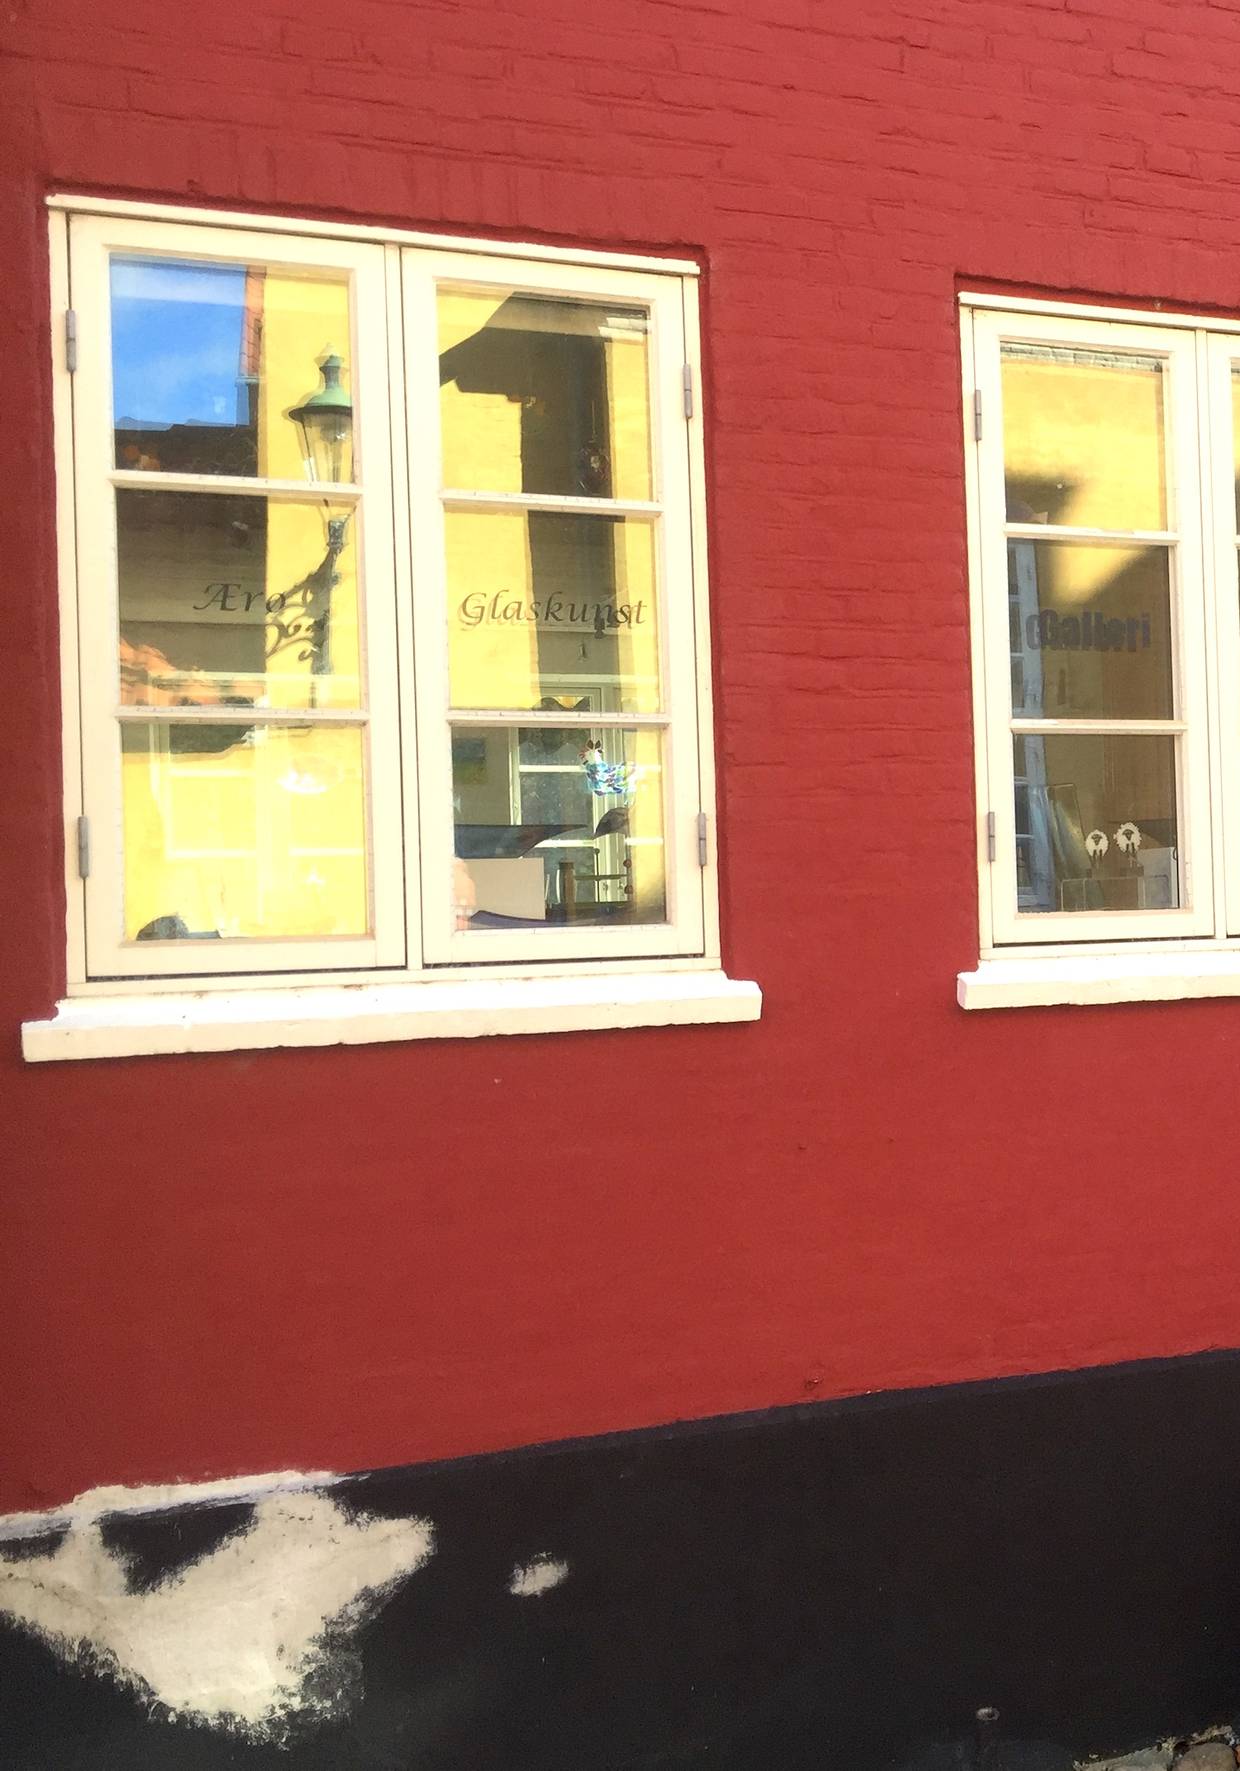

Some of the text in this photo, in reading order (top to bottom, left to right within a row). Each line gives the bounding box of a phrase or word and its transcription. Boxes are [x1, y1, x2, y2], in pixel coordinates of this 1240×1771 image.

[192, 582, 647, 625] Ærø Glaskunst
[1030, 608, 1151, 651] Galleri
